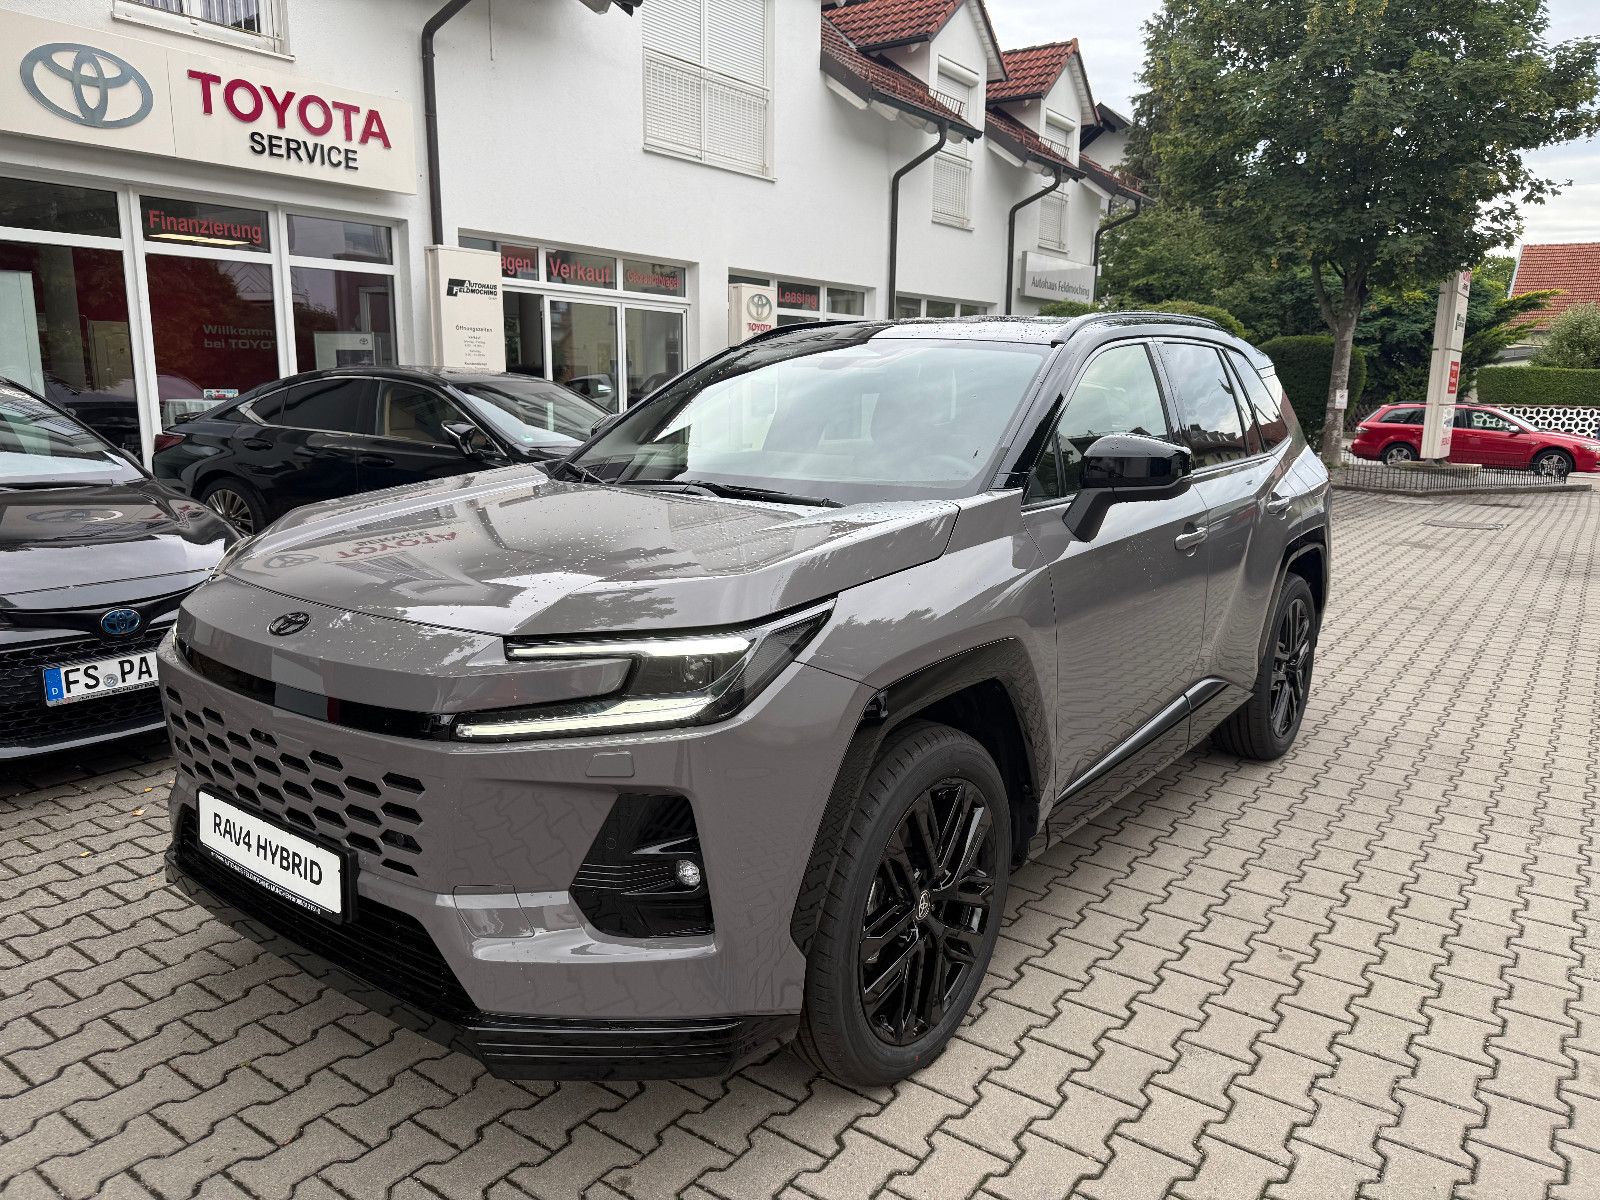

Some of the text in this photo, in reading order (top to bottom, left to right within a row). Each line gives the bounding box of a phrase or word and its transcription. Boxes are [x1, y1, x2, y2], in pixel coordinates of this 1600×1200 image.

[187, 69, 391, 149] TOYOTA
[249, 131, 359, 171] SERVICE
[149, 209, 262, 244] Finanzierung
[550, 258, 610, 284] Verkauf
[1031, 276, 1057, 291] Autohaus
[464, 280, 498, 290] AUTOHAUS
[778, 287, 817, 310] Leasing
[204, 338, 225, 349] bei
[64, 656, 153, 694] FS PA
[52, 687, 59, 695] D
[213, 812, 323, 886] RAV4 HYBRID
